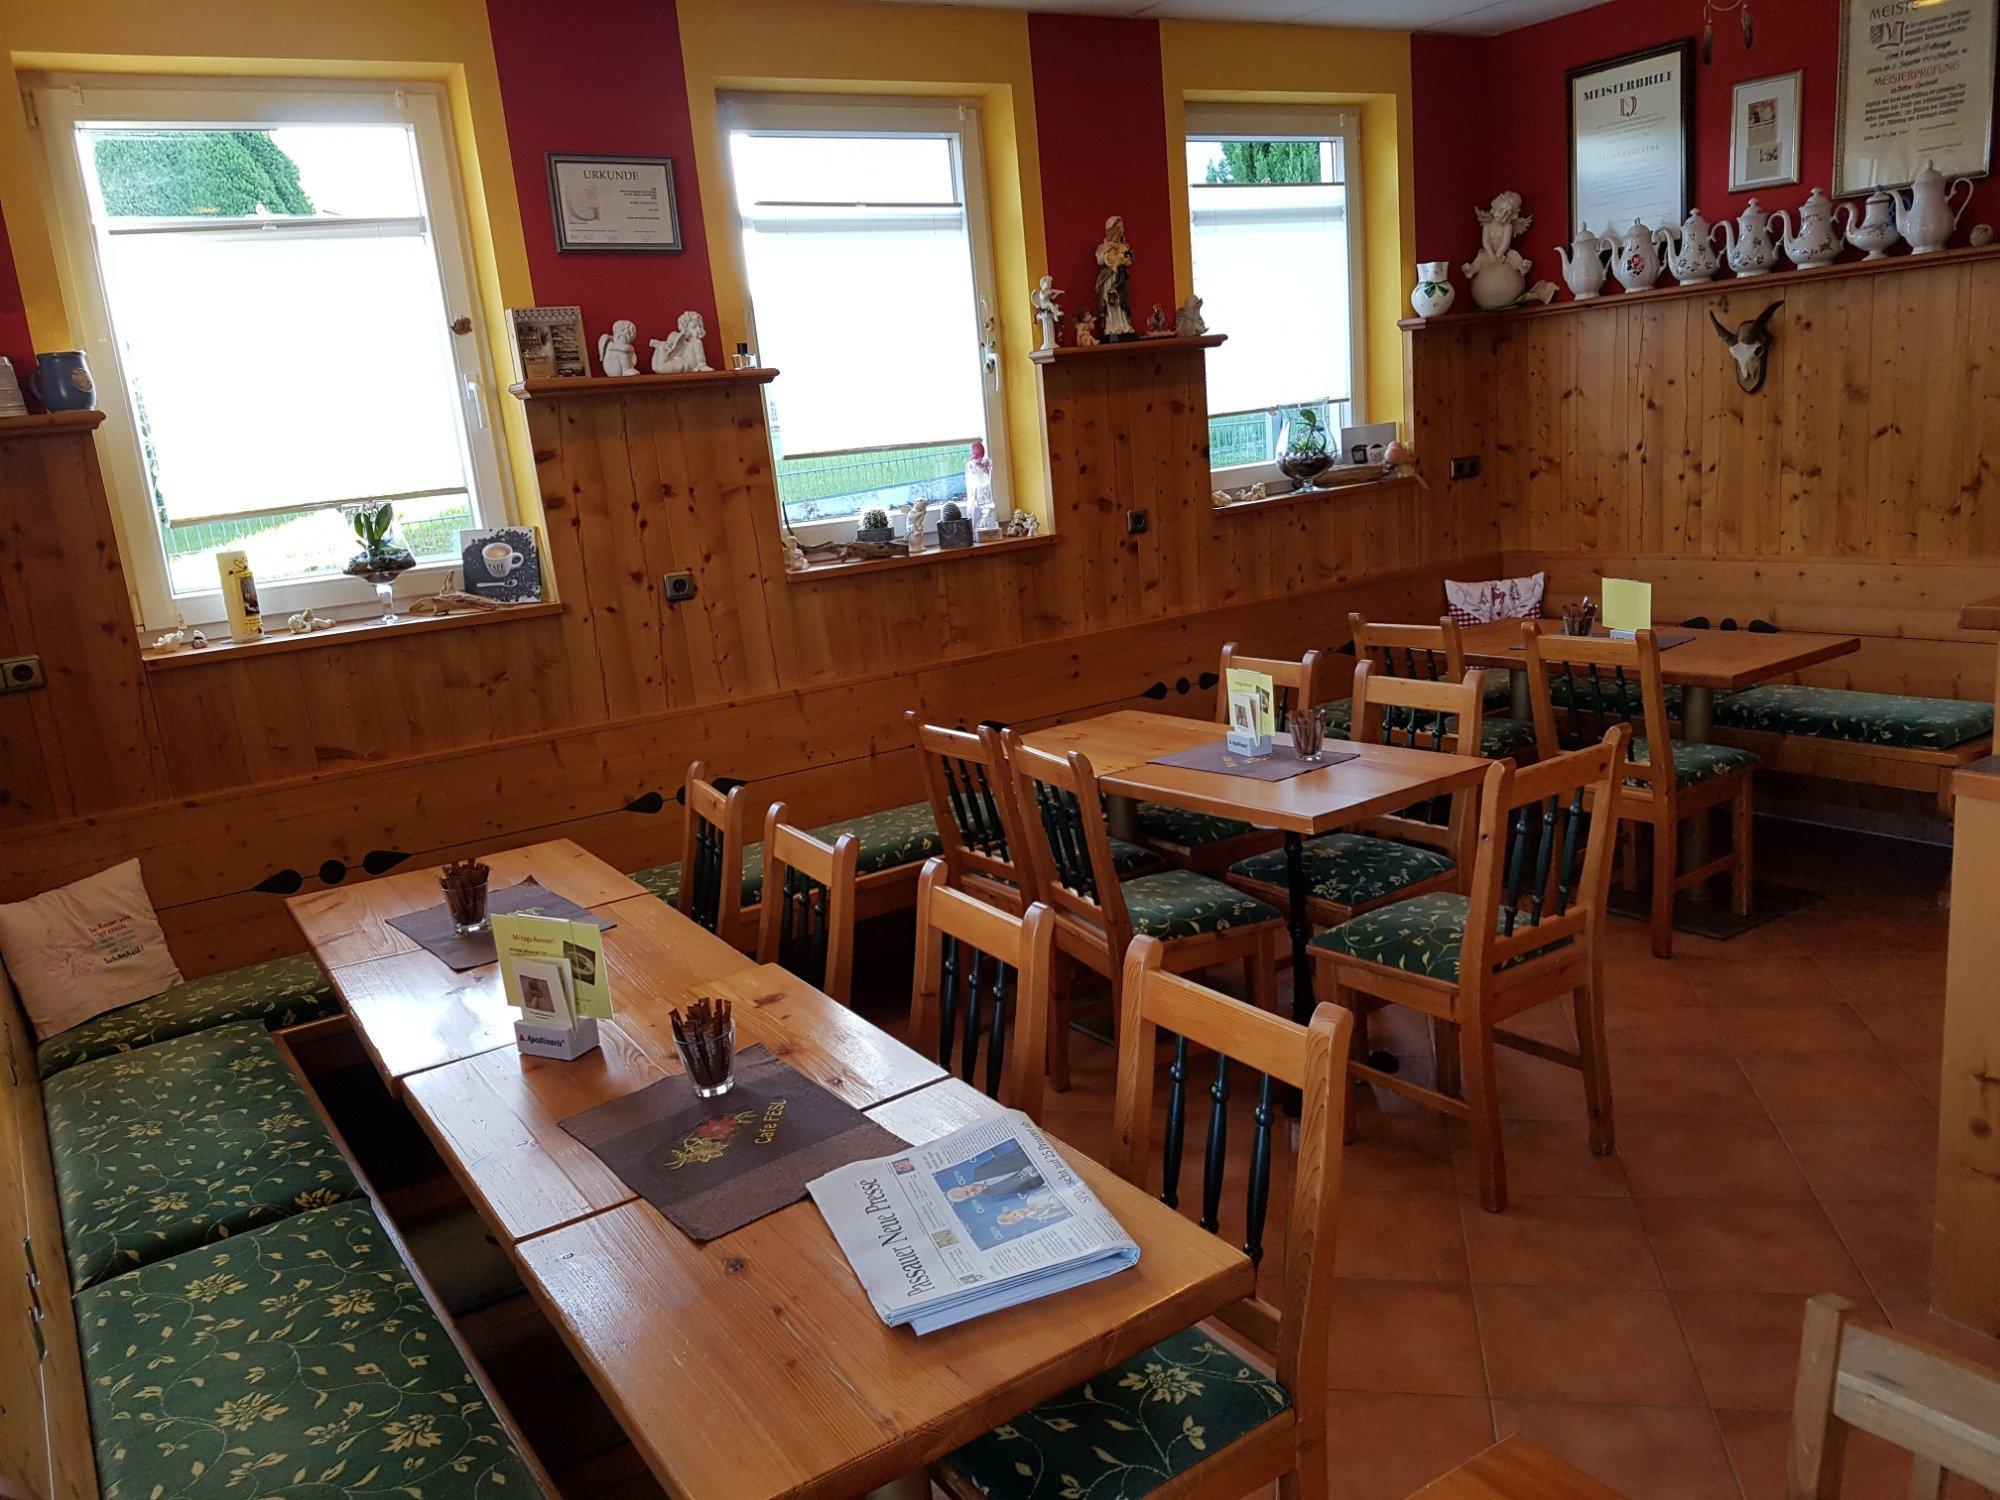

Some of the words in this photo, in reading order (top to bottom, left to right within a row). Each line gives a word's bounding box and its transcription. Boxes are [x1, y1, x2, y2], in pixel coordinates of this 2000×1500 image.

[1583, 70, 1673, 102] MEISTERBRIEF
[583, 170, 640, 181] URKUNDE
[1042, 1150, 1056, 1162] 25
[860, 1179, 891, 1215] Presse
[878, 1213, 907, 1247] Neue
[892, 1245, 935, 1298] Passauer
